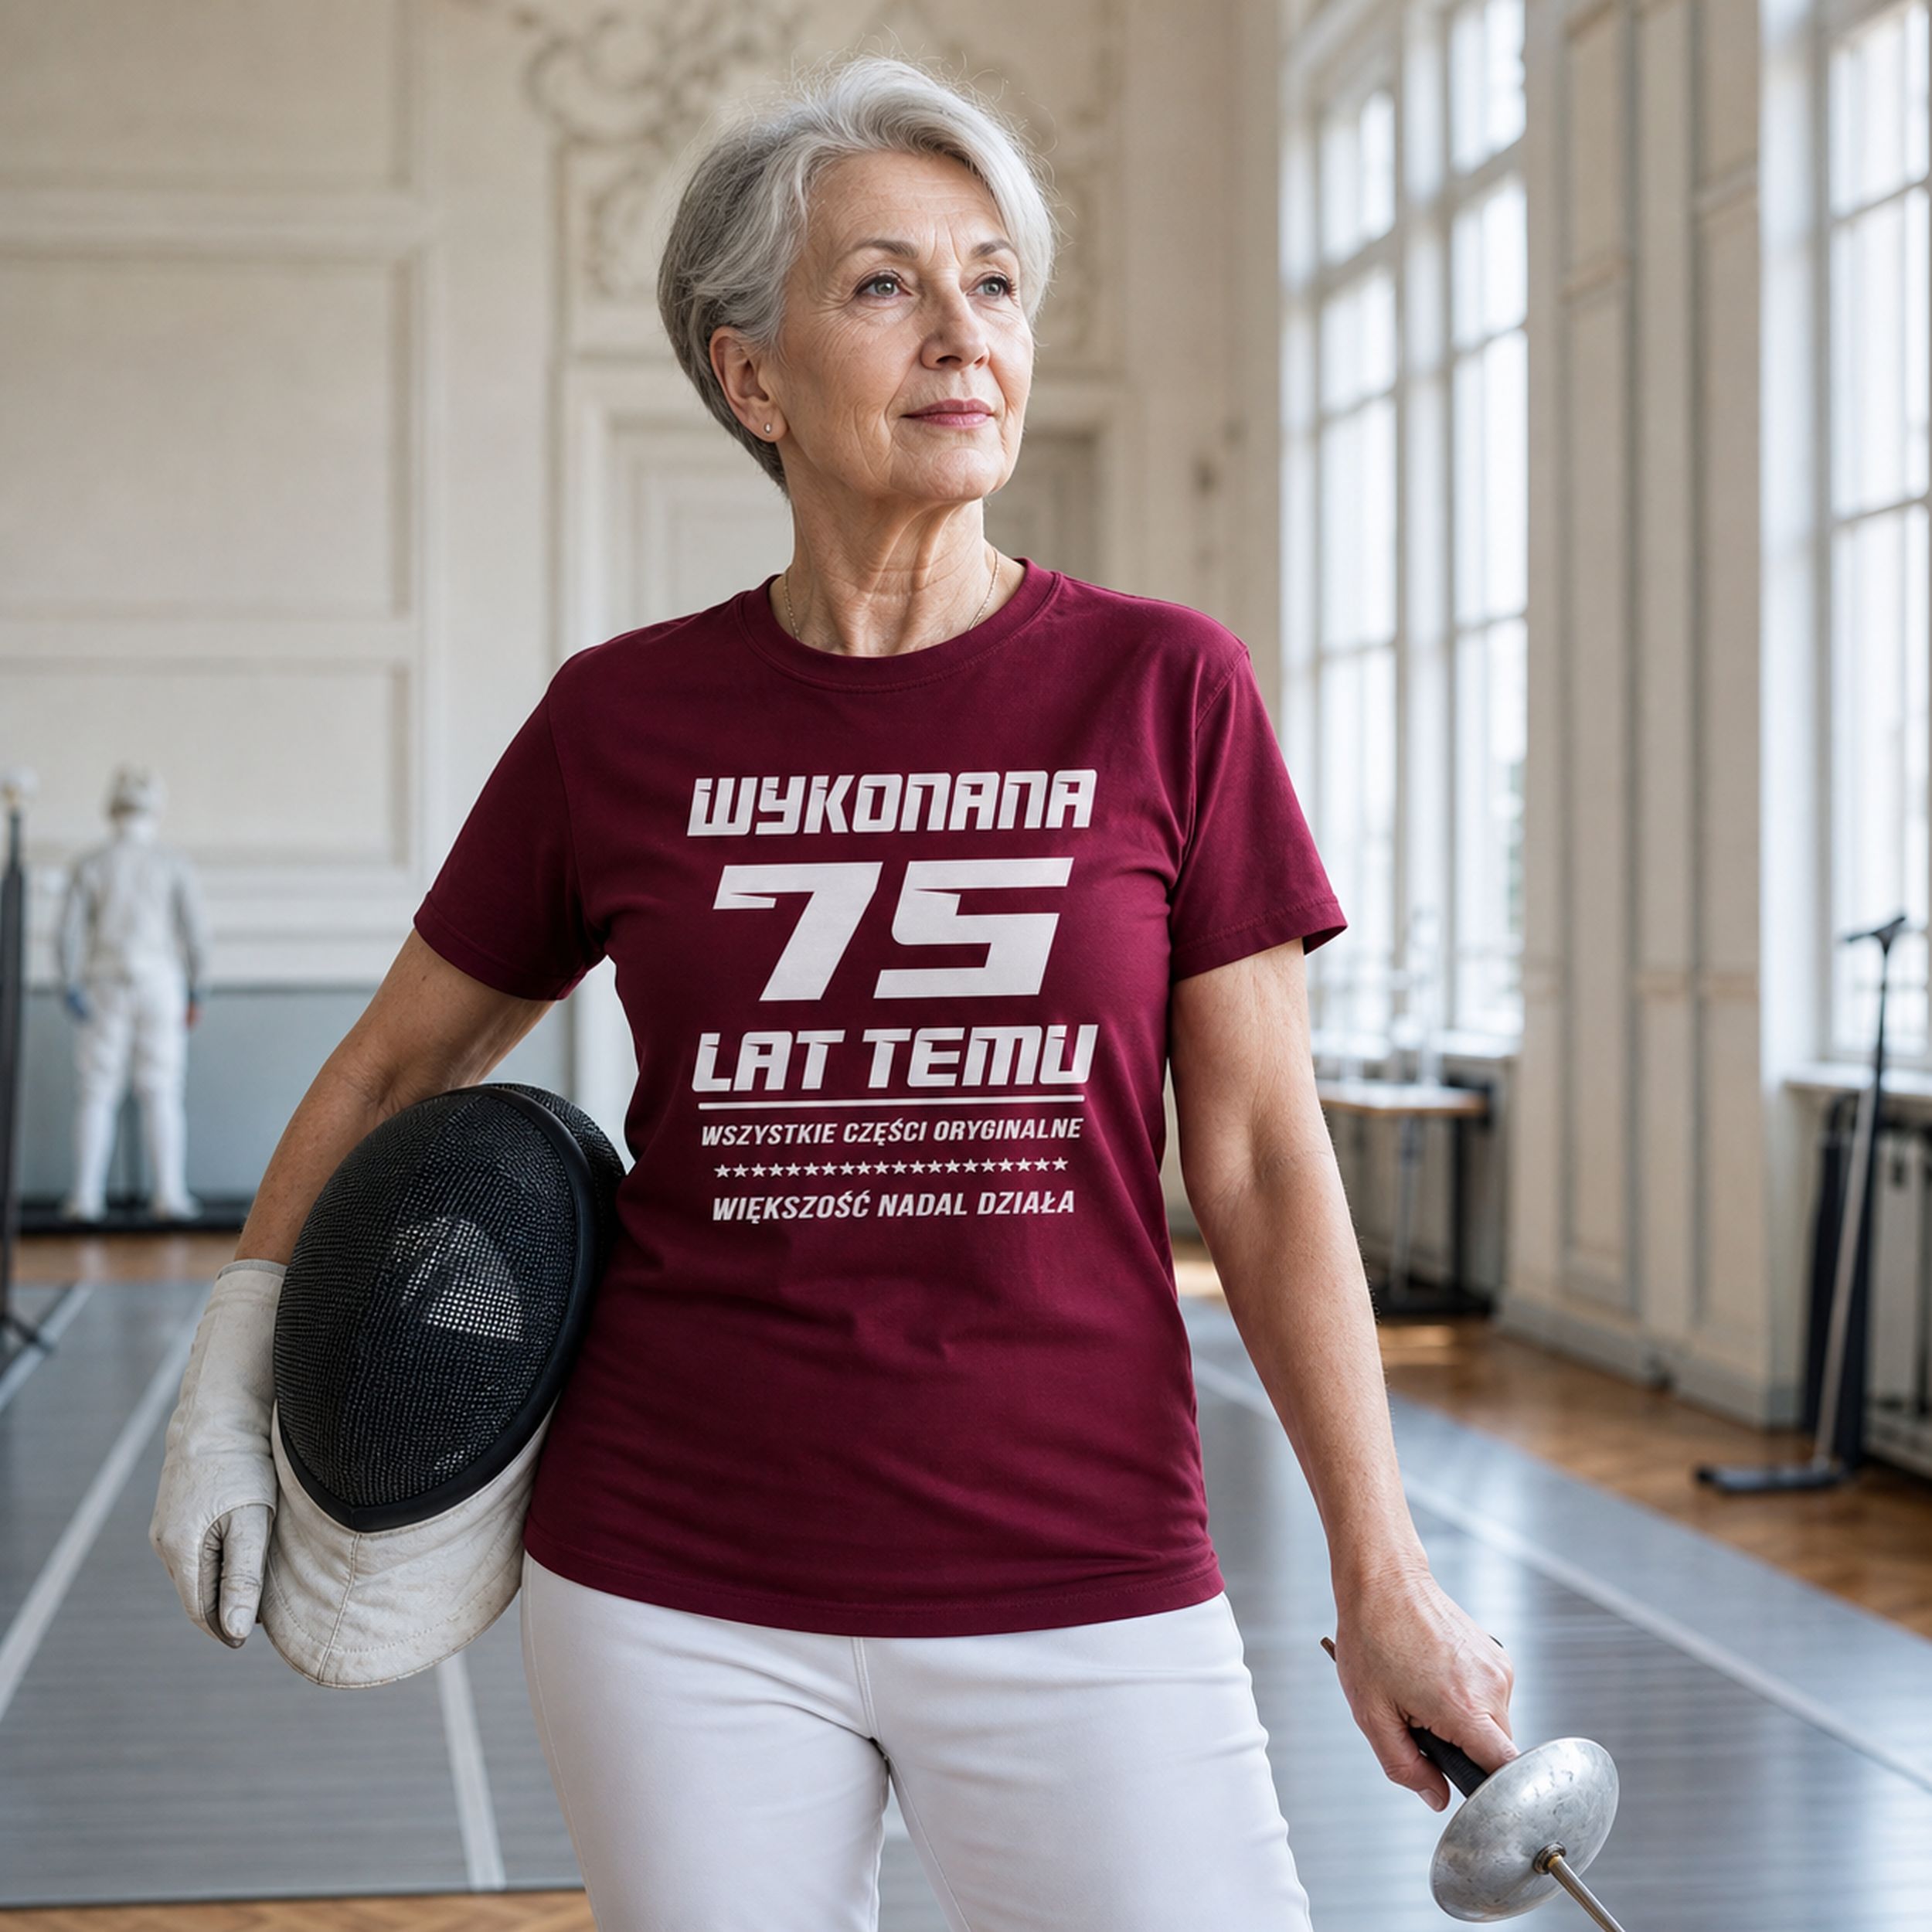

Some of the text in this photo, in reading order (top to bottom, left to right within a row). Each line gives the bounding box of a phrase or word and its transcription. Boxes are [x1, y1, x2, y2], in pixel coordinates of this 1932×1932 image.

[687, 770, 1097, 836] WYKONANA
[713, 857, 1074, 1001] 75
[692, 1025, 1098, 1092] LAT TEMU
[701, 1117, 1084, 1146] WSZYSTKIE CZĘŚCI ORYGINALNE
[713, 1190, 1074, 1224] WIĘKSZOŚĆ NADAL DZIAŁA
